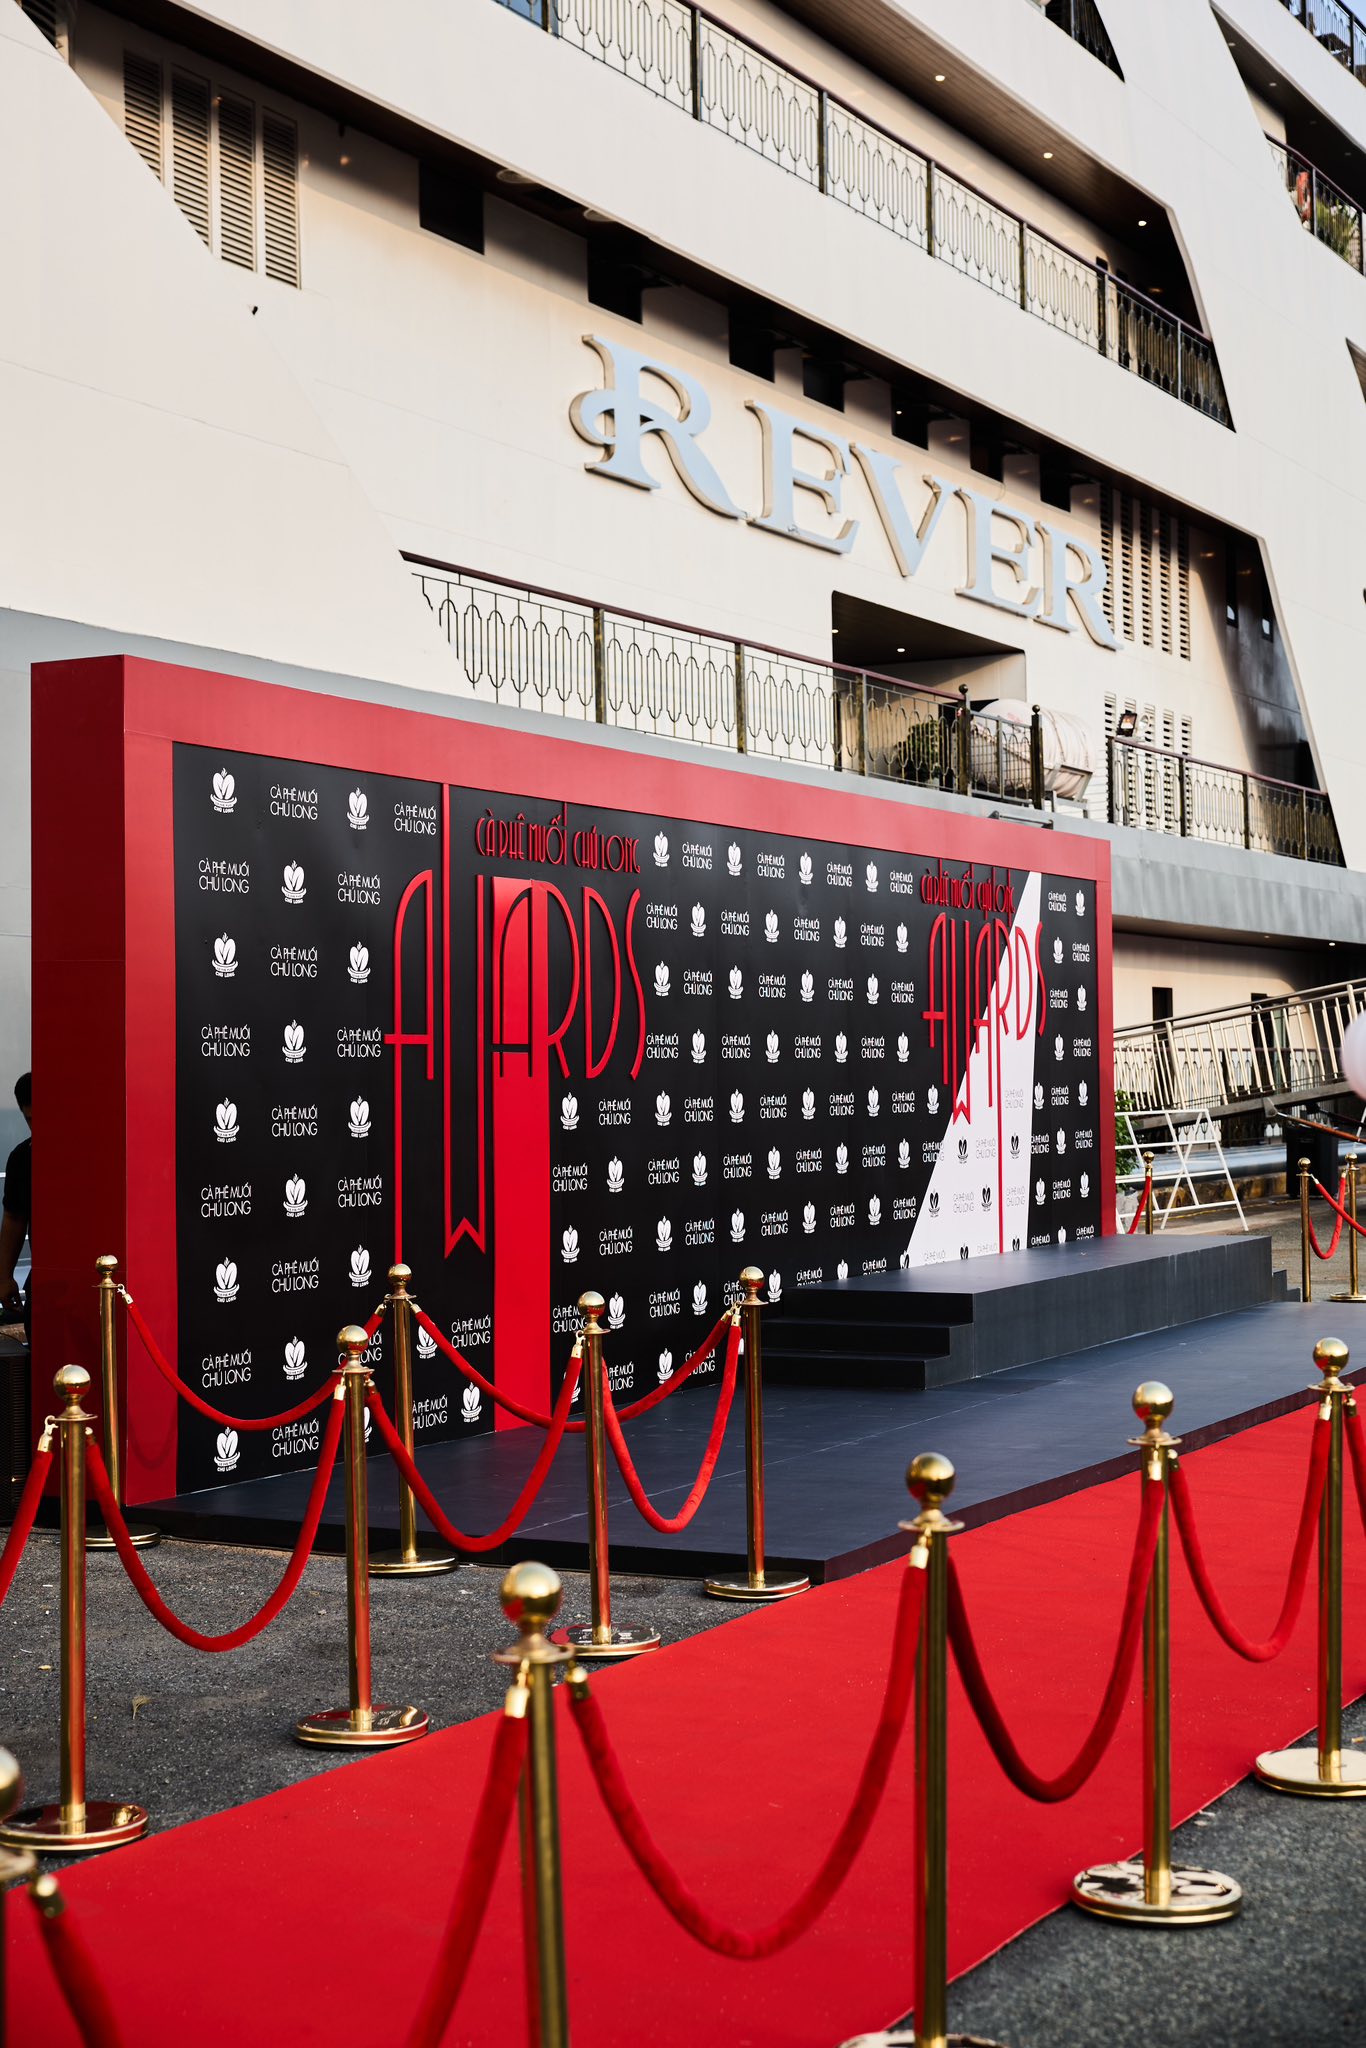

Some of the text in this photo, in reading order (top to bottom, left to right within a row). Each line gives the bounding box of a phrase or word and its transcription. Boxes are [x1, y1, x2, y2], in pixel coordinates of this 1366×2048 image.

[569, 333, 1124, 651] REVER
[270, 800, 318, 820] CHÚ LONG
[394, 817, 436, 835] CHÚ LONG
[600, 833, 641, 874] LONG
[199, 874, 249, 893] CHÚ LONG
[338, 885, 380, 905] CHÚ LONG
[271, 960, 317, 977] CHÚ LONG
[202, 1038, 250, 1056] CHÚ LONG
[337, 1040, 381, 1057] CHÚ LONG
[272, 1120, 317, 1137] CHÚ LONG
[338, 1191, 381, 1207] CHÚ LONG
[201, 1200, 251, 1217] CHÚ LONG
[272, 1275, 318, 1292] CHÚ LONG
[469, 1331, 490, 1345] LONG
[202, 1367, 251, 1388] CHÚ LONG
[412, 1411, 424, 1430] HÚ
[273, 1436, 319, 1457] CHÚ LONG
